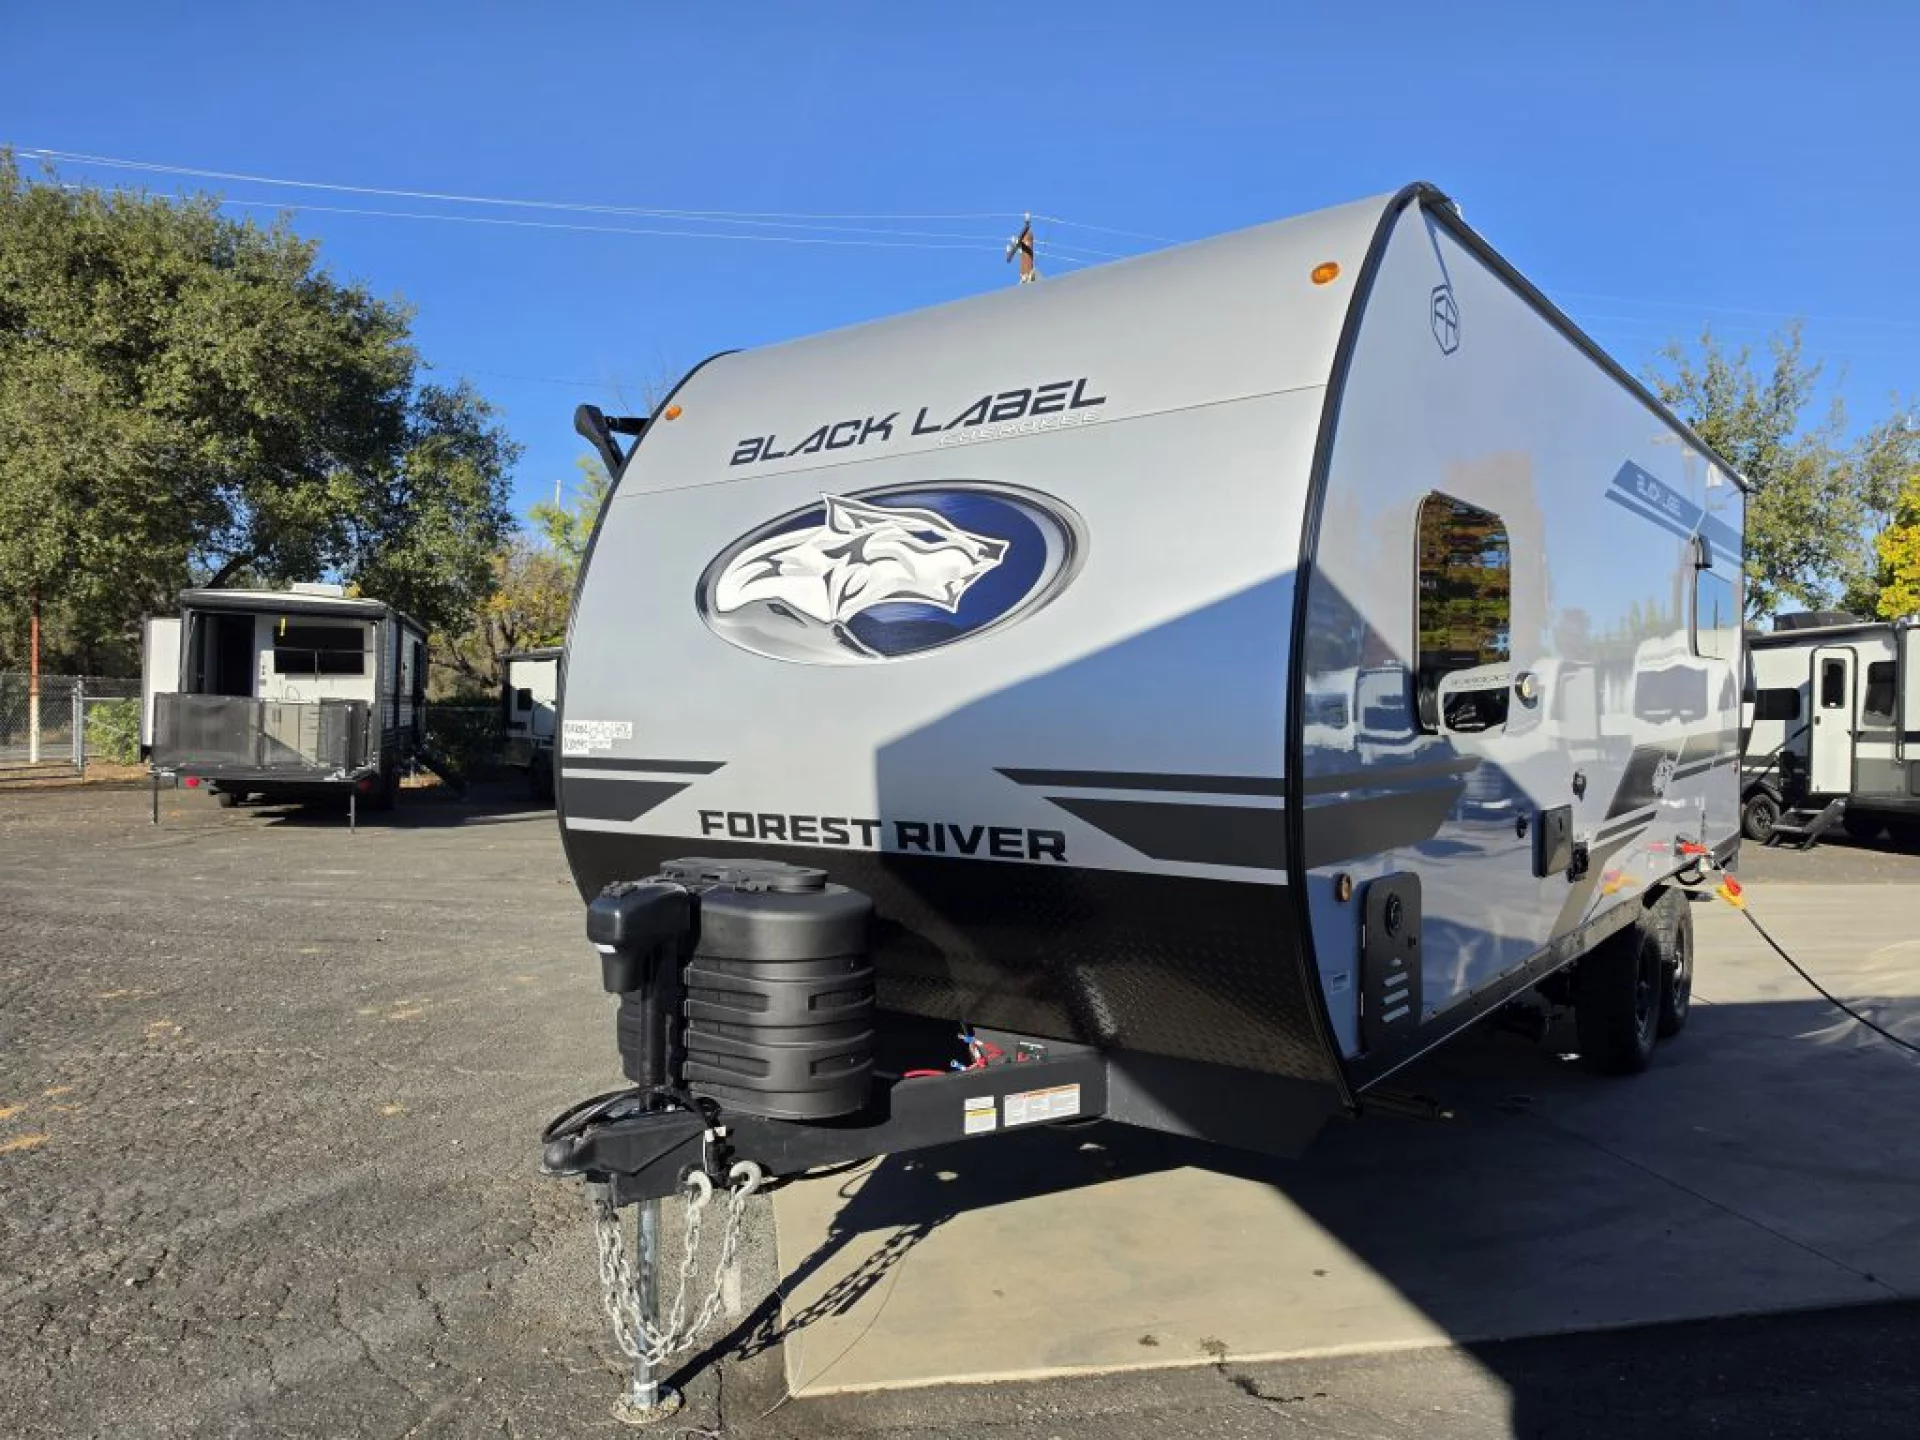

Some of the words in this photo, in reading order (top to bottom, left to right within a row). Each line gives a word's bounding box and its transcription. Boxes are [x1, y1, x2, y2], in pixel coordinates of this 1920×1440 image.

[729, 412, 900, 465] BLACK
[911, 378, 1106, 436] LABEL
[698, 809, 881, 847] FOREST
[893, 820, 1068, 862] RIVER
